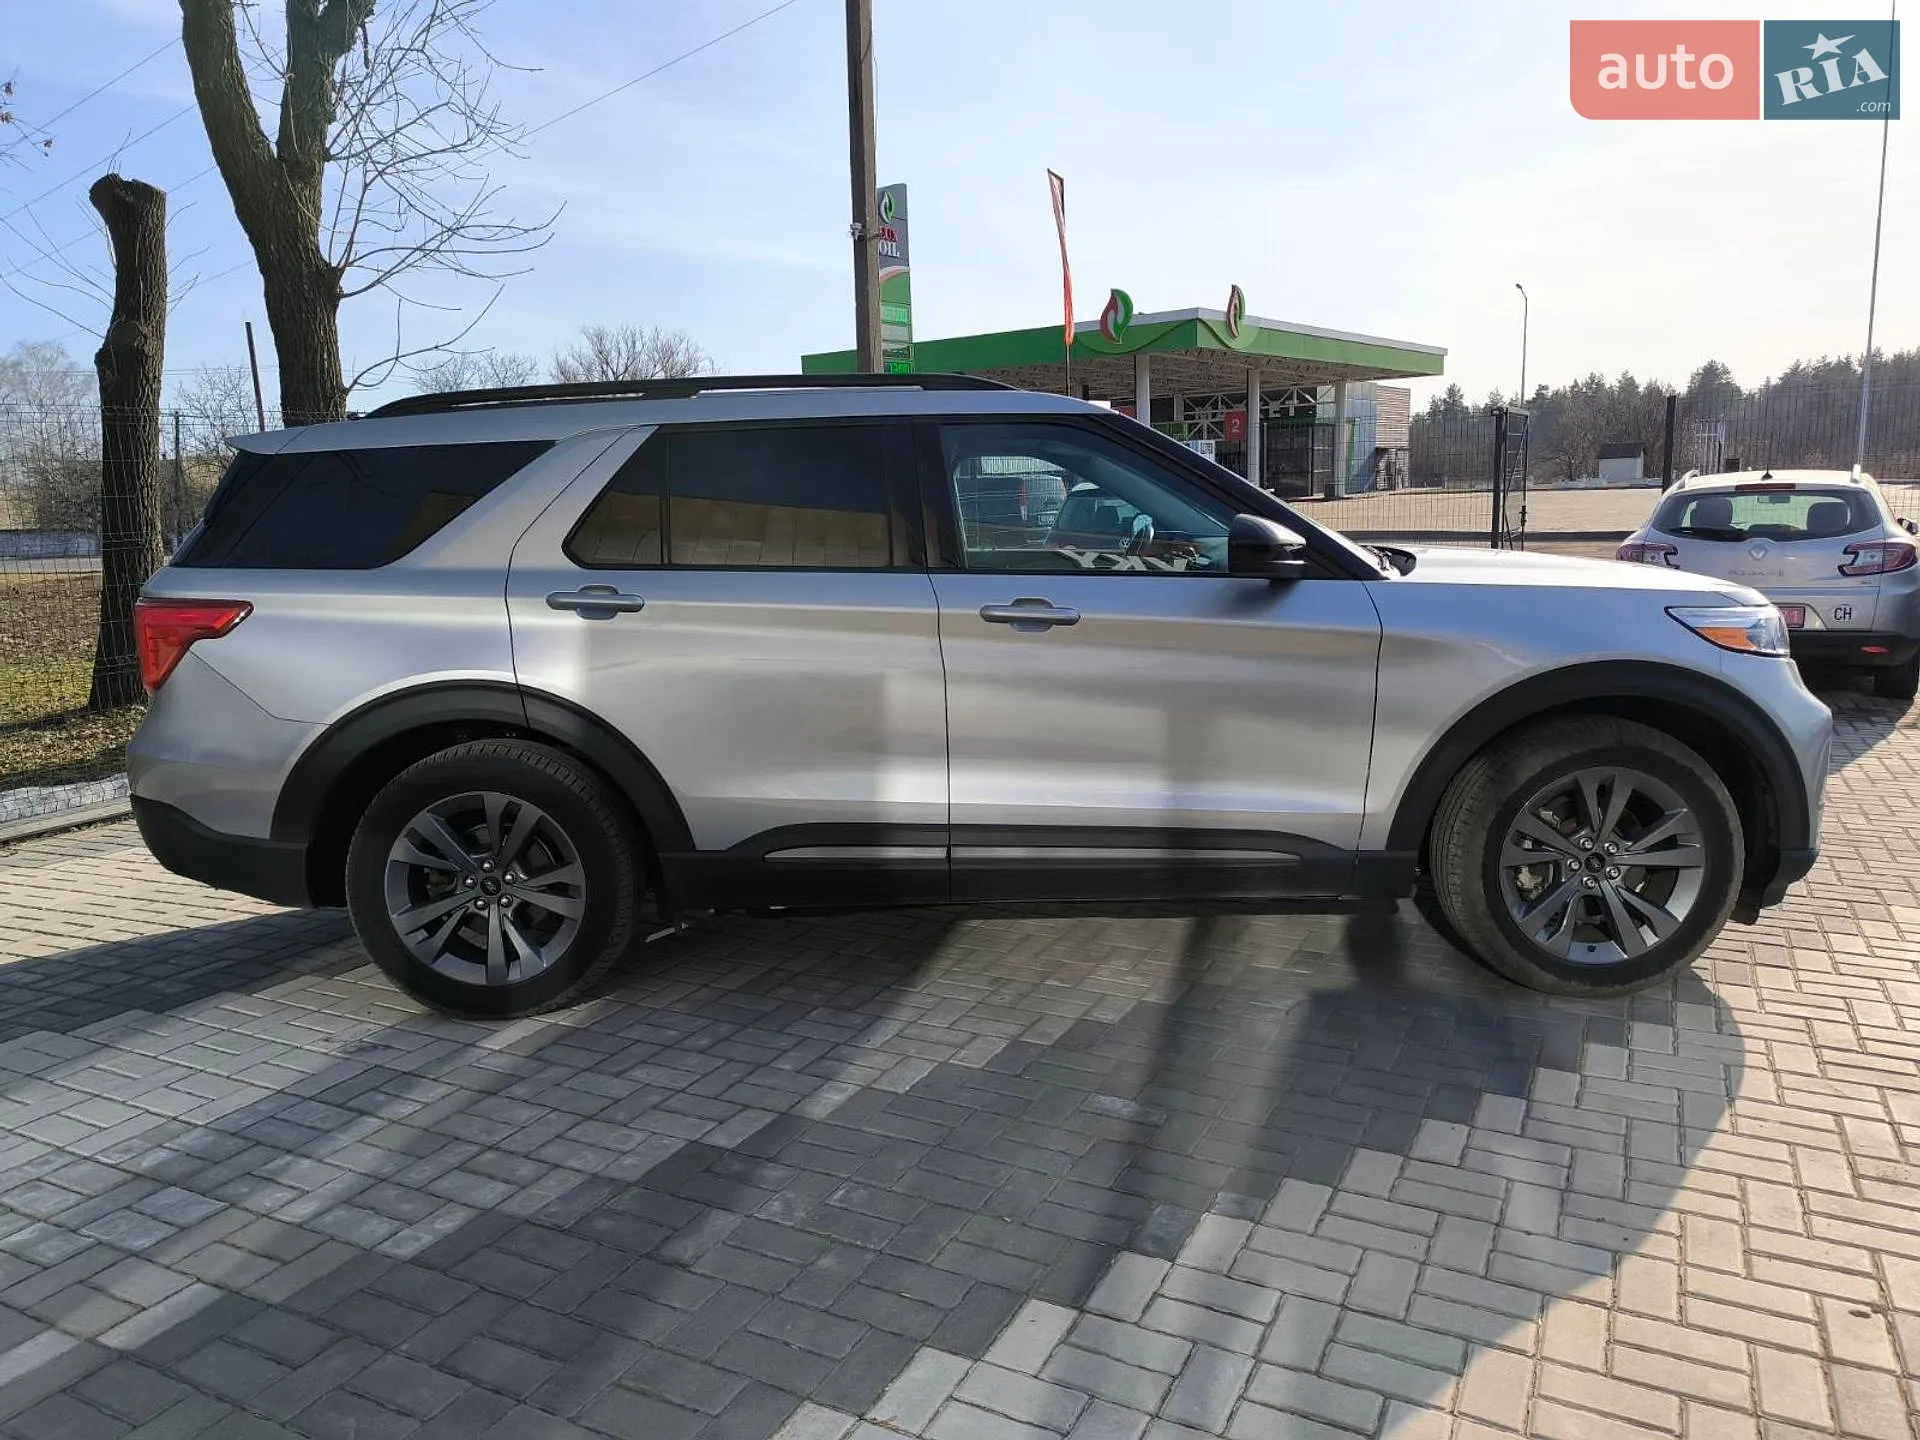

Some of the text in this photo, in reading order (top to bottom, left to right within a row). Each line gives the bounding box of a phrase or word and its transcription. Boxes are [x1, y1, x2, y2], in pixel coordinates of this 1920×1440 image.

[879, 239, 900, 258] OIL
[1231, 418, 1241, 433] 2
[1834, 607, 1852, 621] CH
